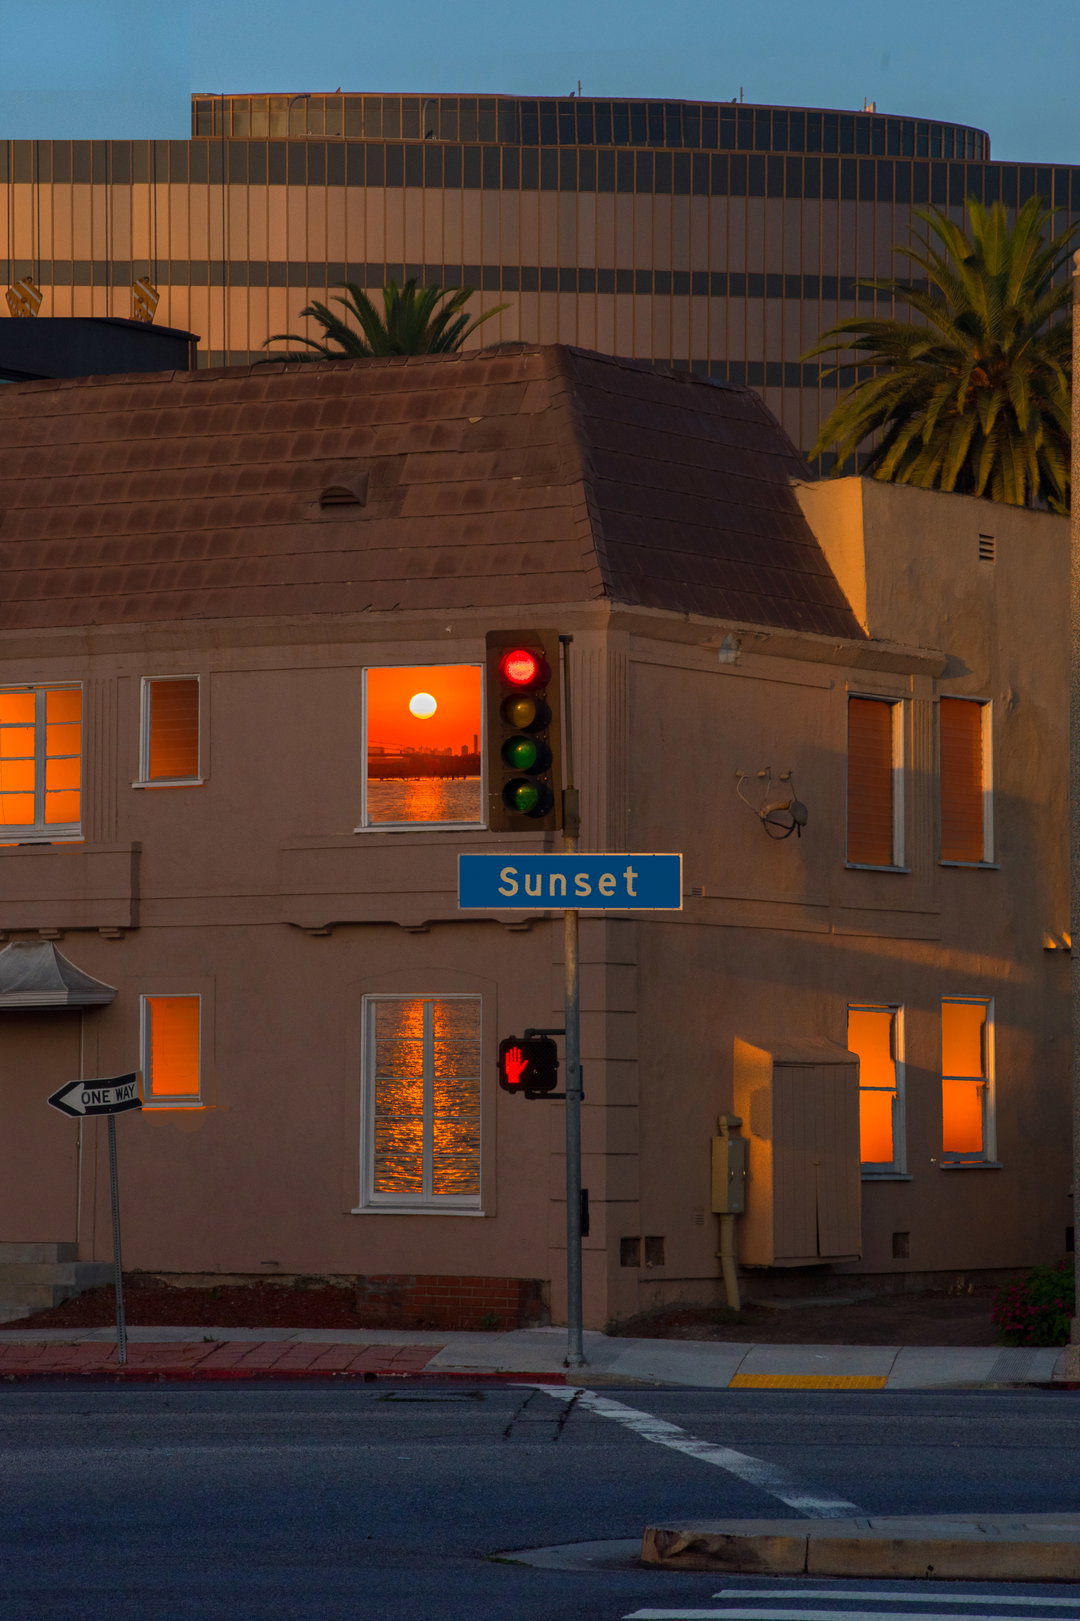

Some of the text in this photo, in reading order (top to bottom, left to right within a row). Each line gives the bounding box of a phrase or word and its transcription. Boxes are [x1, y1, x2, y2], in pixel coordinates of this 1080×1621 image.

[498, 866, 638, 897] Sunset
[81, 1084, 135, 1105] ONE WAY
